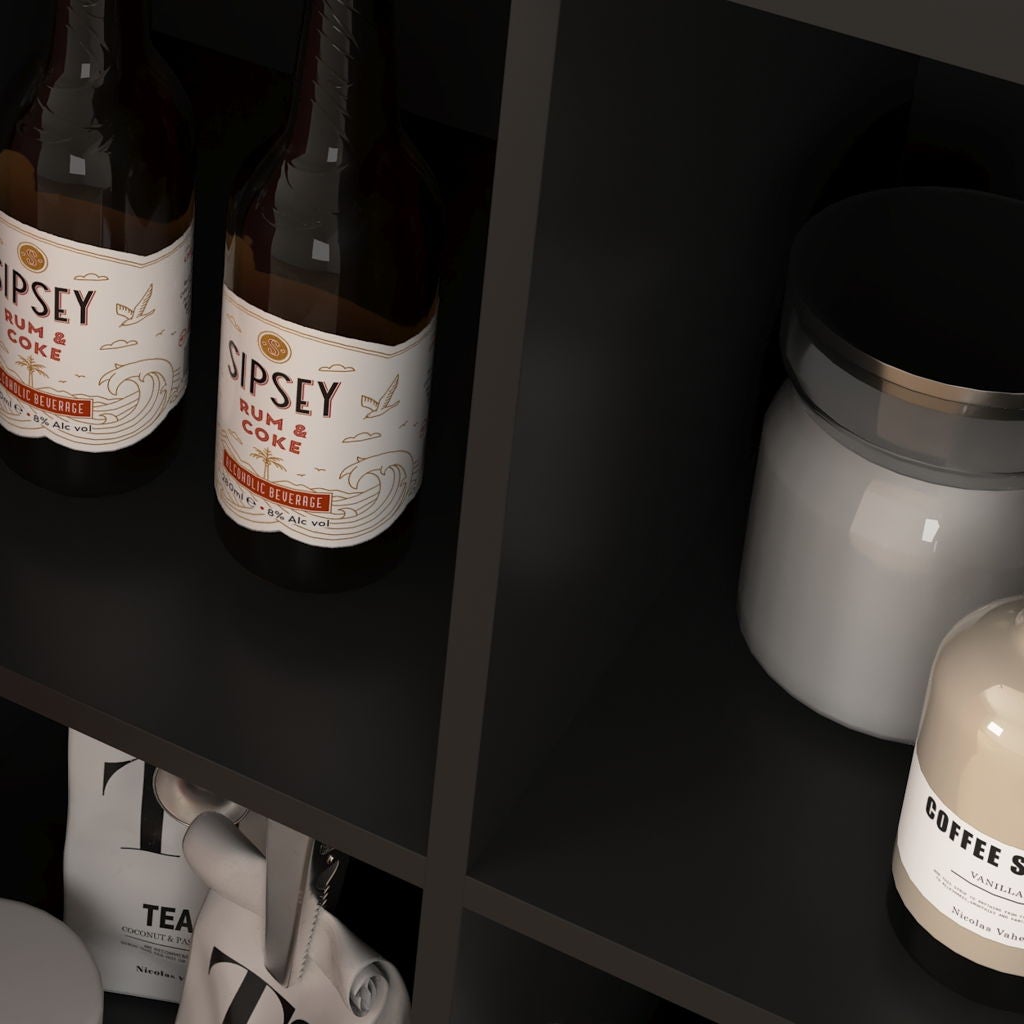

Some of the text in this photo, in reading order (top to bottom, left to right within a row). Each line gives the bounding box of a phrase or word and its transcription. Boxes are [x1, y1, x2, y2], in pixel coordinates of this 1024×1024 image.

[4, 308, 67, 346] RUM &
[6, 329, 63, 362] COKE
[227, 340, 341, 419] SIPSEY
[34, 394, 85, 415] BEVERAGE
[239, 398, 308, 438] RUM &
[32, 414, 50, 426] 8%
[52, 421, 71, 431] Alc
[74, 424, 93, 432] vol
[241, 420, 303, 455] COKE
[224, 455, 323, 509] ALCOHOLIC BEVERAGE
[267, 508, 284, 521] 8%
[288, 515, 307, 526] Alc
[311, 519, 330, 527] vol
[925, 795, 1002, 868] COFFEE
[970, 870, 1023, 898] VANILLA
[142, 903, 194, 933] TEA
[951, 905, 992, 932] Nicolas
[121, 926, 166, 942] COCONUT
[136, 965, 175, 979] Nicolas
